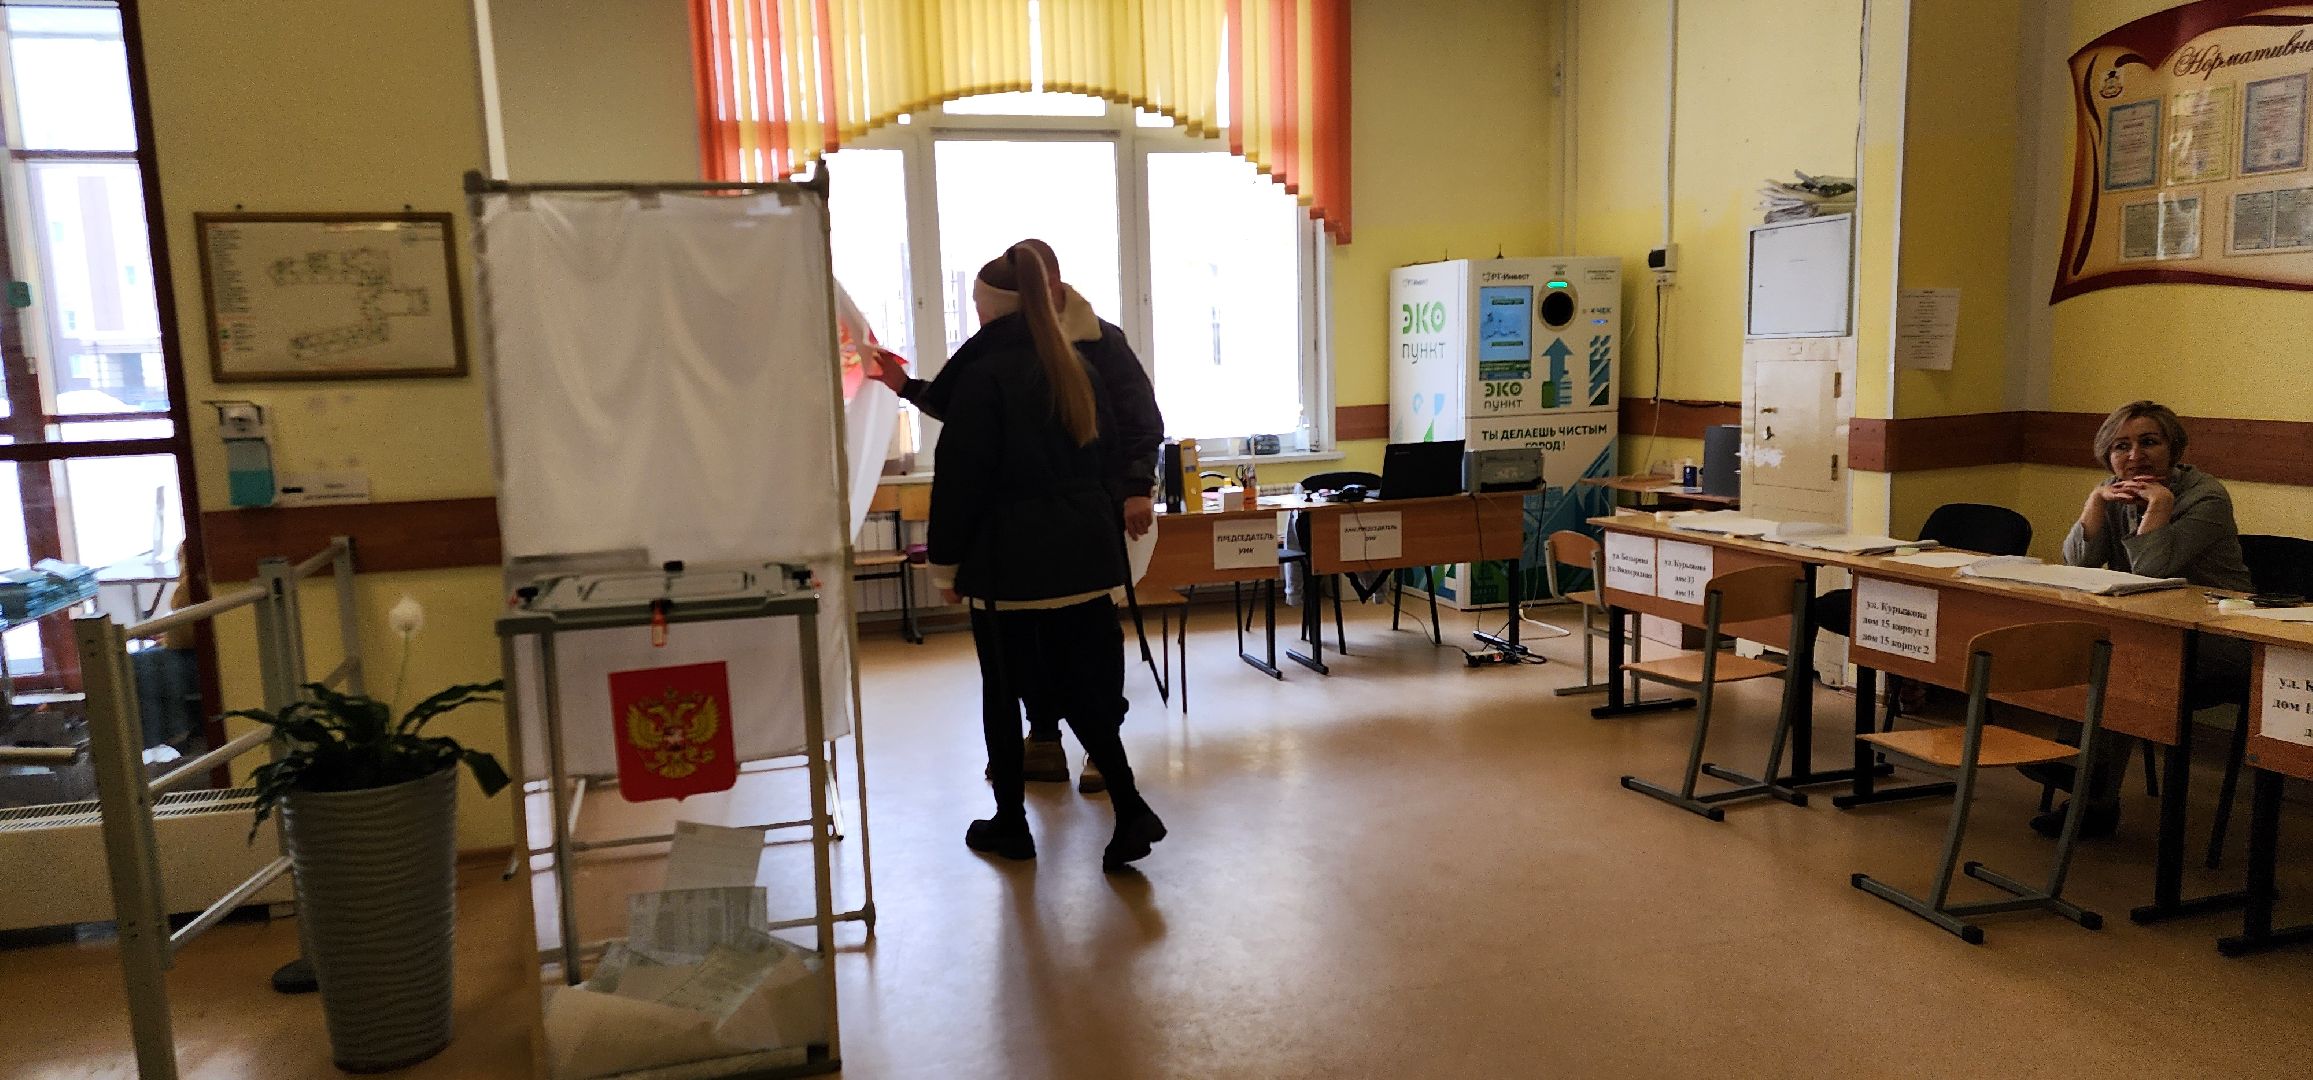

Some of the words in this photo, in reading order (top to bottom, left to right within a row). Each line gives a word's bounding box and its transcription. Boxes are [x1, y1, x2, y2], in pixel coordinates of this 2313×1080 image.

[1402, 302, 1446, 334] ЭКО
[1402, 342, 1446, 364] пункт
[1484, 382, 1523, 398] ЭКО
[1484, 399, 1523, 412] пункт
[1482, 430, 1498, 440] ТЫ
[1500, 426, 1556, 441] ДЕЛАЕШЬ
[1559, 424, 1607, 436] ЧИСТЫМ
[1217, 533, 1274, 543] ПРЕДСЕДАТЕЛЬ
[1862, 617, 1879, 626] дом
[1881, 619, 1890, 628] 15
[1892, 623, 1923, 637] корпус
[1924, 628, 1930, 638] 1
[1862, 634, 1878, 643] дом
[1880, 635, 1890, 646] 15
[1891, 640, 1922, 654] корпус
[1923, 645, 1930, 655] 2
[2272, 699, 2300, 712] дом
